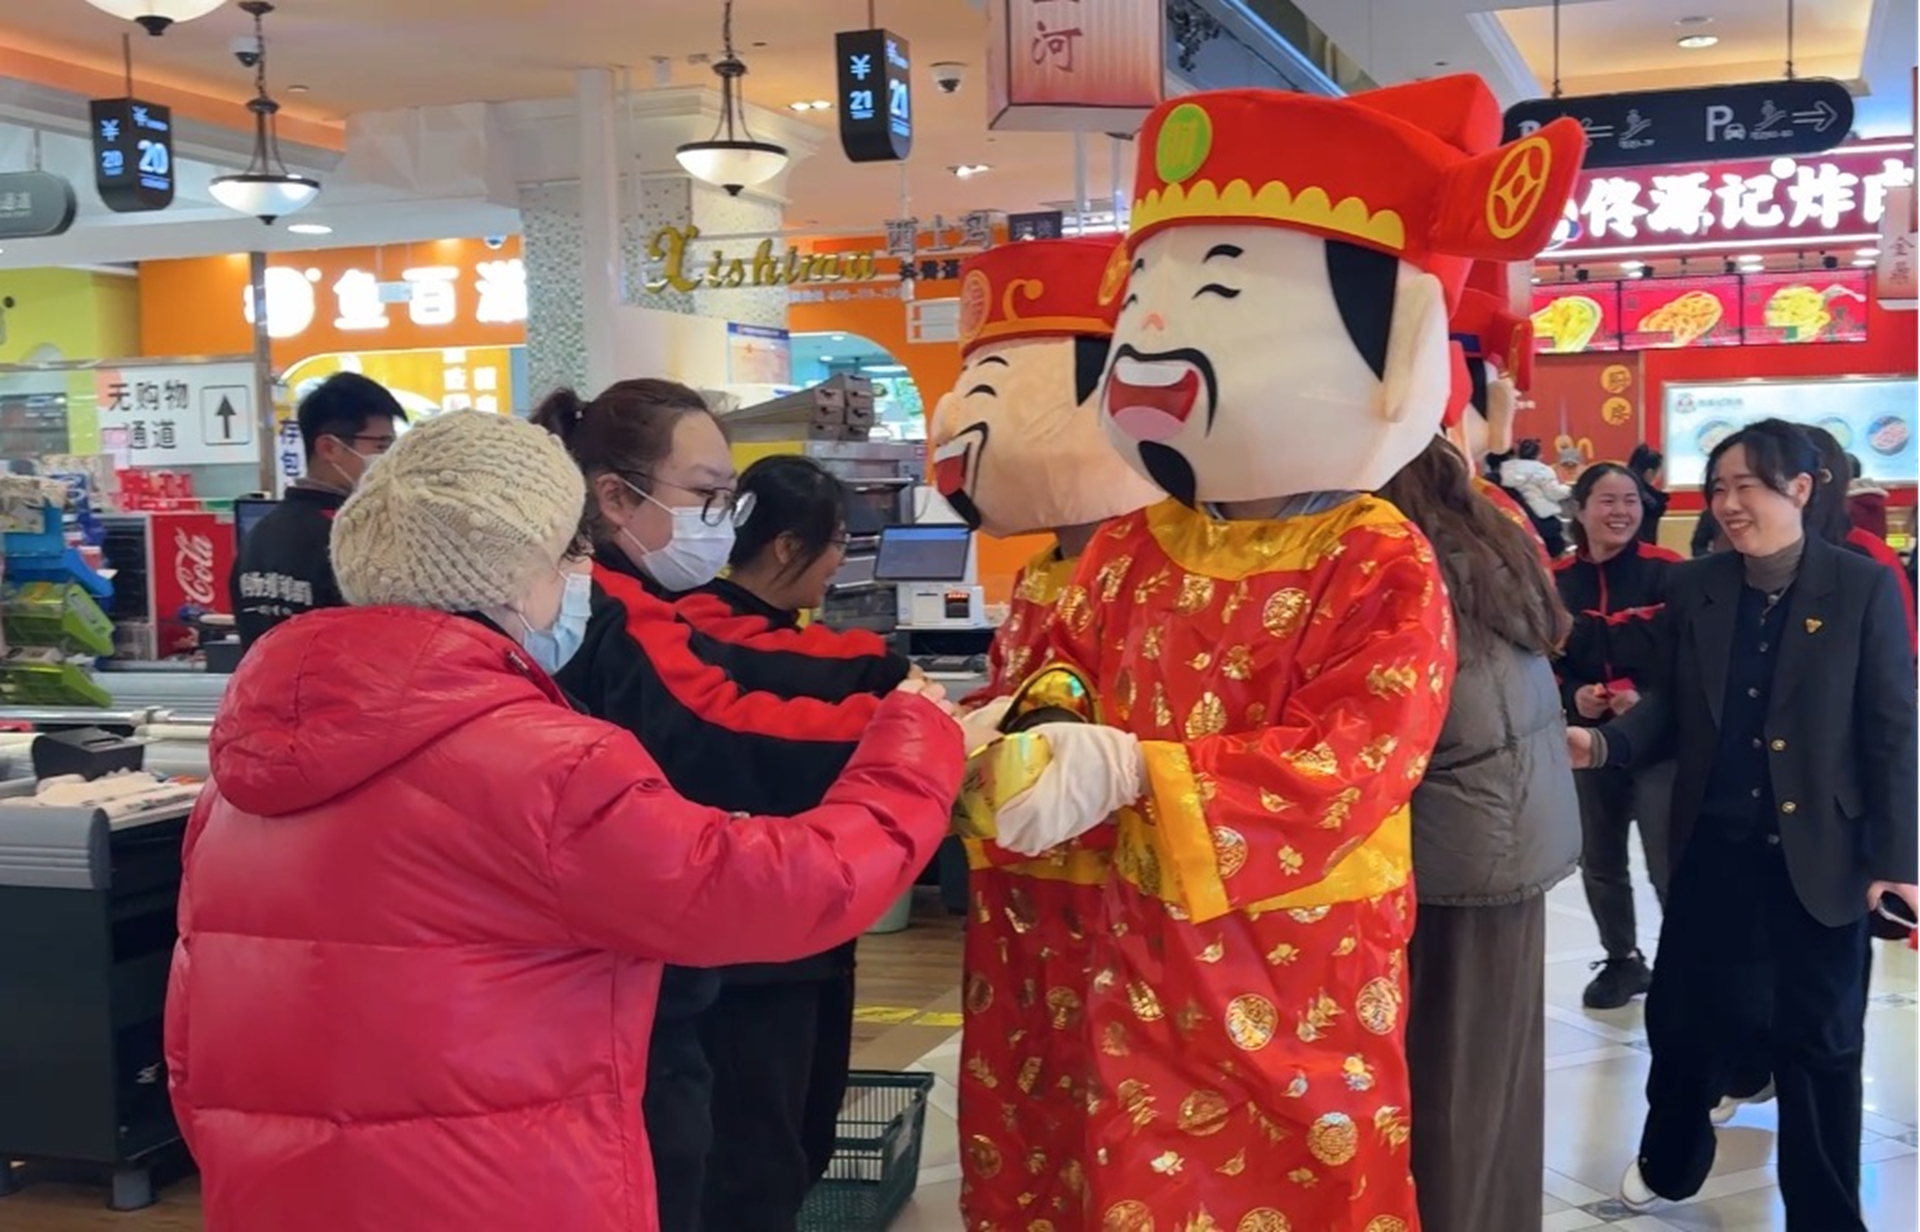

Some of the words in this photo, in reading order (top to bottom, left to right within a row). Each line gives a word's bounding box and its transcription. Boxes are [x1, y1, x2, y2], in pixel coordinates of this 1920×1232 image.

[849, 90, 872, 110] 21
[890, 79, 909, 119] 21
[1706, 105, 1734, 142] P
[138, 140, 168, 174] 20
[107, 379, 189, 411] 无购物
[128, 419, 177, 449] 通道
